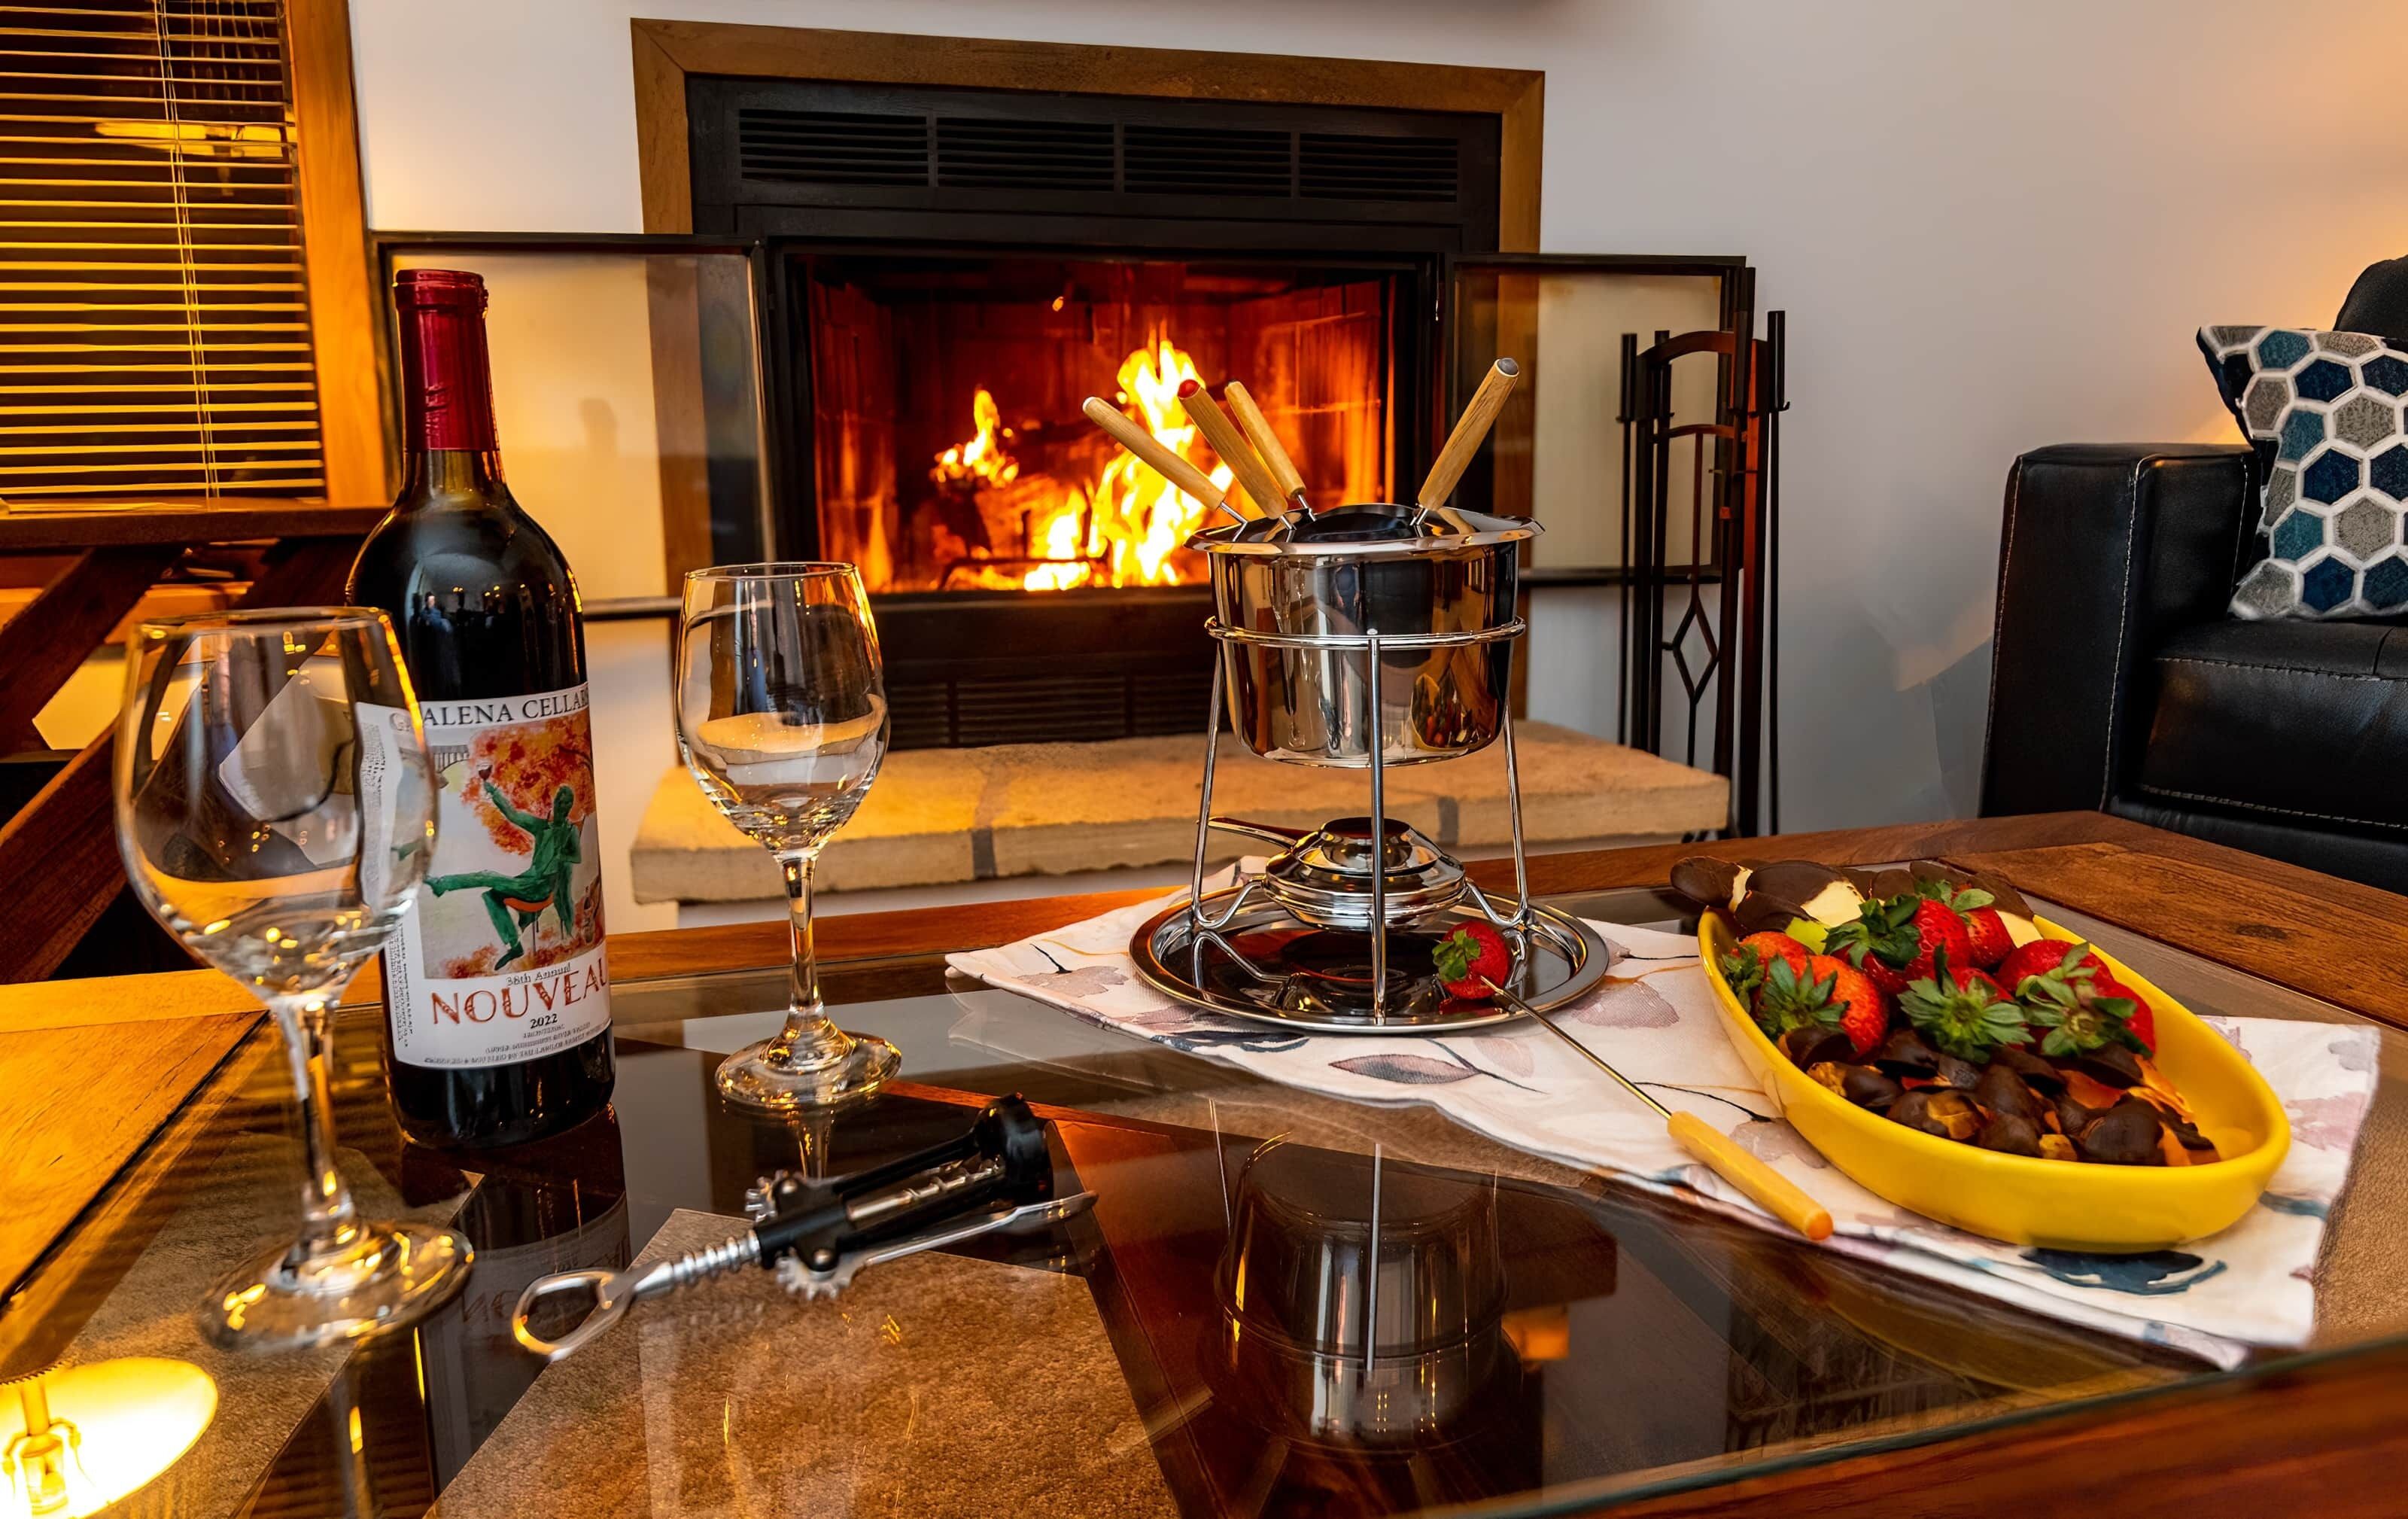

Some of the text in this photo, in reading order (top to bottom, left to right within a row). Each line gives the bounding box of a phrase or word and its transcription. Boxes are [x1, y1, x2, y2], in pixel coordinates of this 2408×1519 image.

[507, 962, 571, 986] 38th Annual
[530, 1013, 558, 1030] 2022
